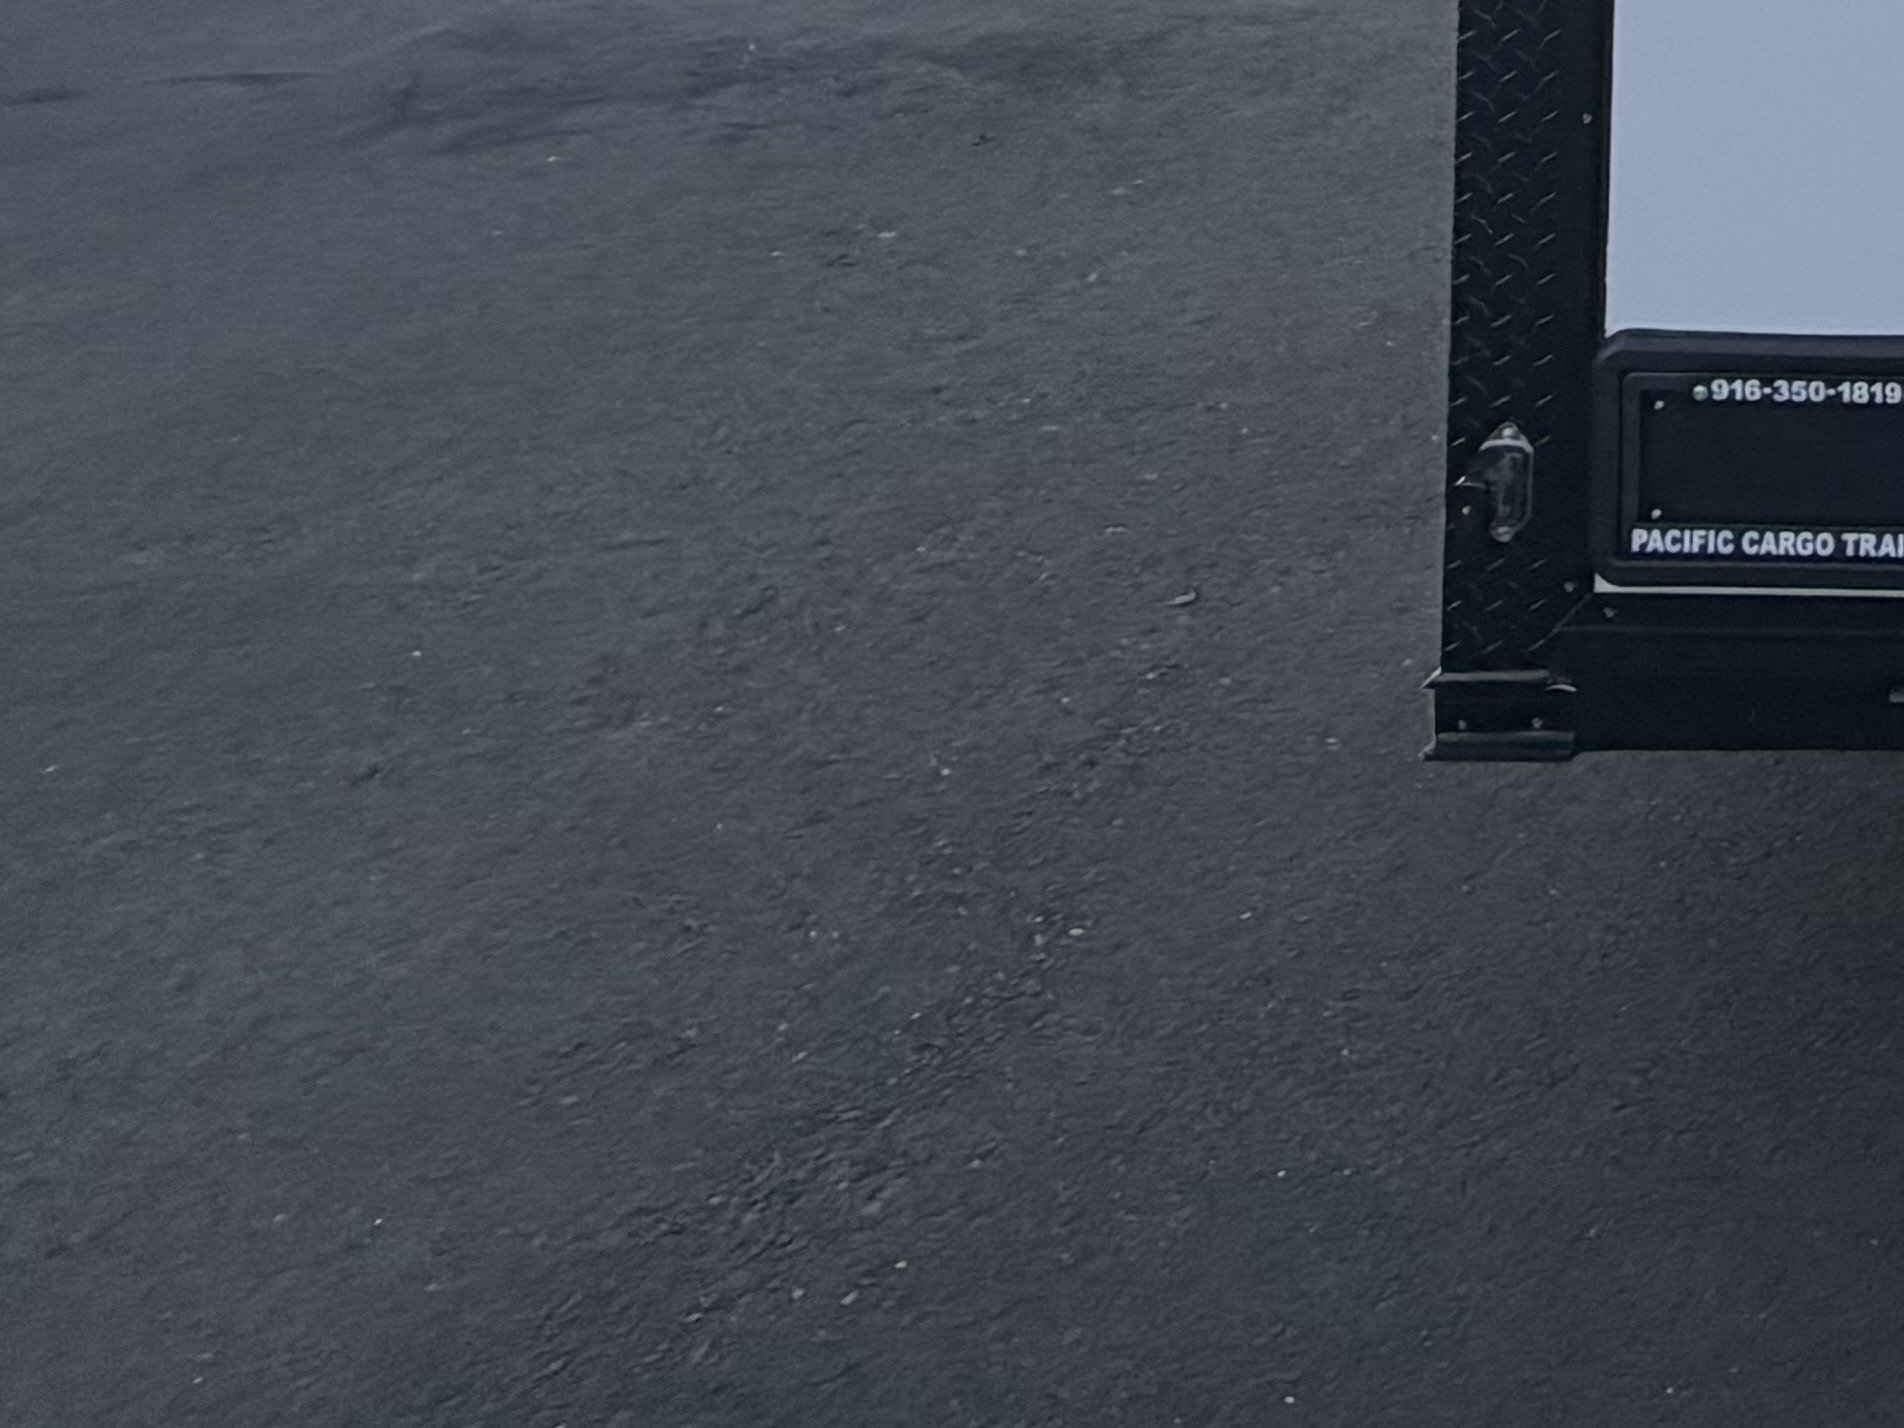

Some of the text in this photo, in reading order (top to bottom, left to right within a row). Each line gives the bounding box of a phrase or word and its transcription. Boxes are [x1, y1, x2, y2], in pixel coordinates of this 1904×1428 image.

[1710, 378, 1902, 405] 916-350-1819
[1631, 527, 1735, 554] PACIFIC
[1741, 529, 1835, 557] CARGO
